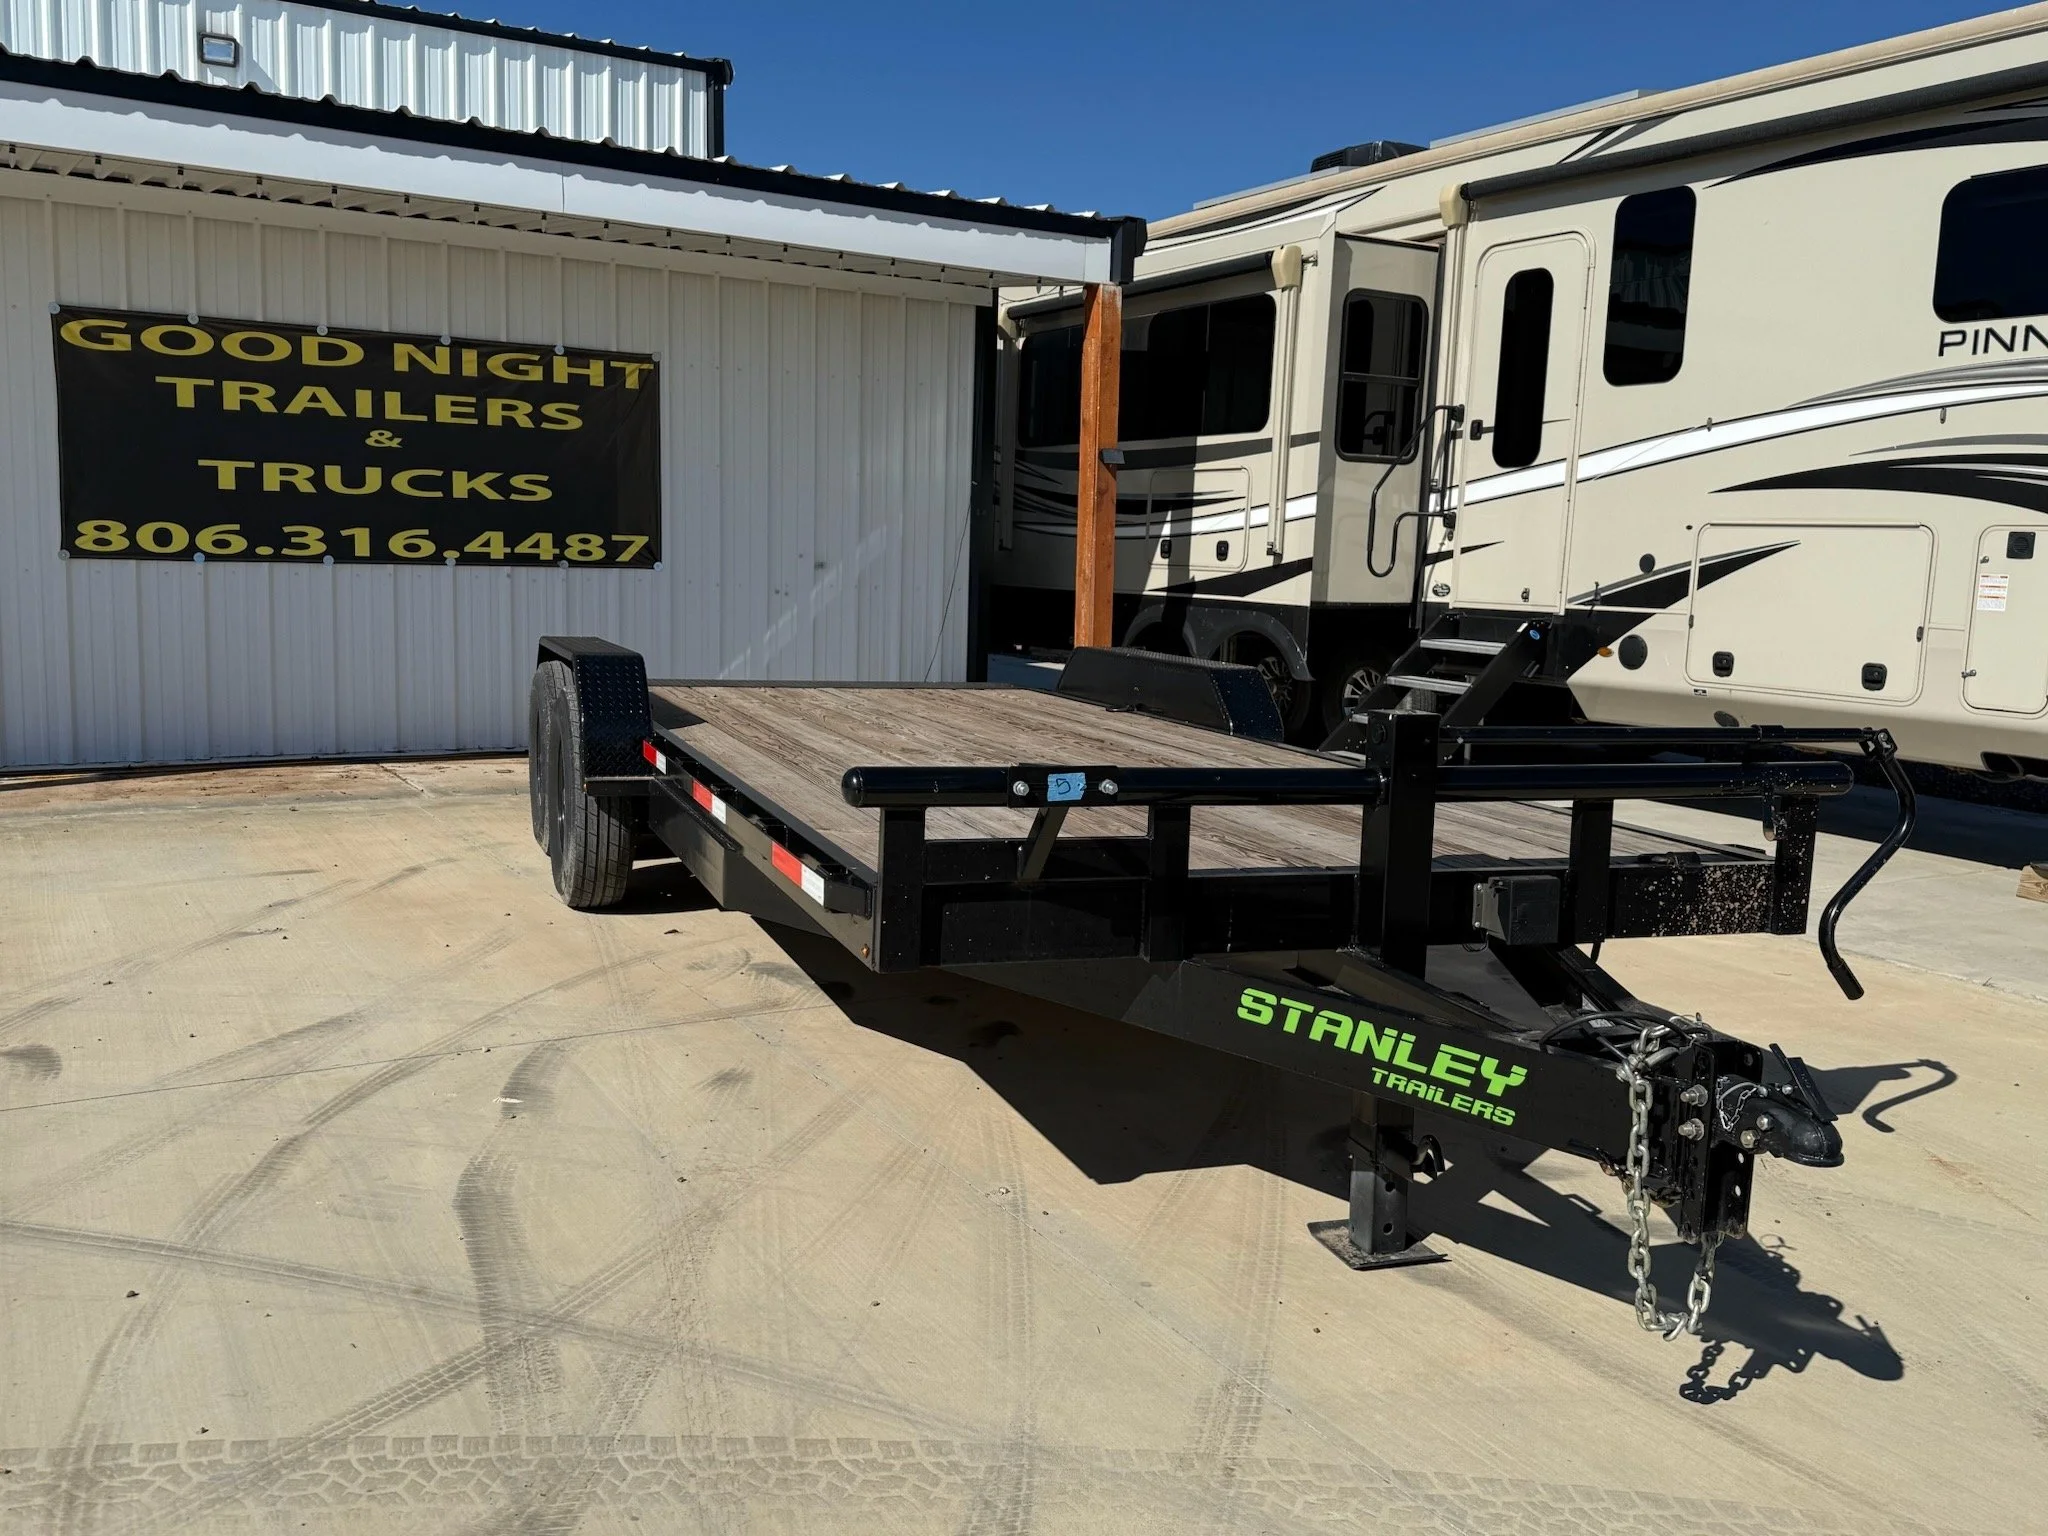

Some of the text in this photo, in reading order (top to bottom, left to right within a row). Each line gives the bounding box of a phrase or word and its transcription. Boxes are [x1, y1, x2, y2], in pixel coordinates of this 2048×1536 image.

[60, 318, 654, 391] GOOD NIGHT
[155, 376, 584, 431] TRAILERS
[365, 430, 402, 448] &
[198, 459, 553, 502] TRUCKS
[74, 519, 650, 563] 806.316.4487
[1237, 987, 1528, 1097] STANLEY
[1371, 1066, 1516, 1126] TRAILERS
